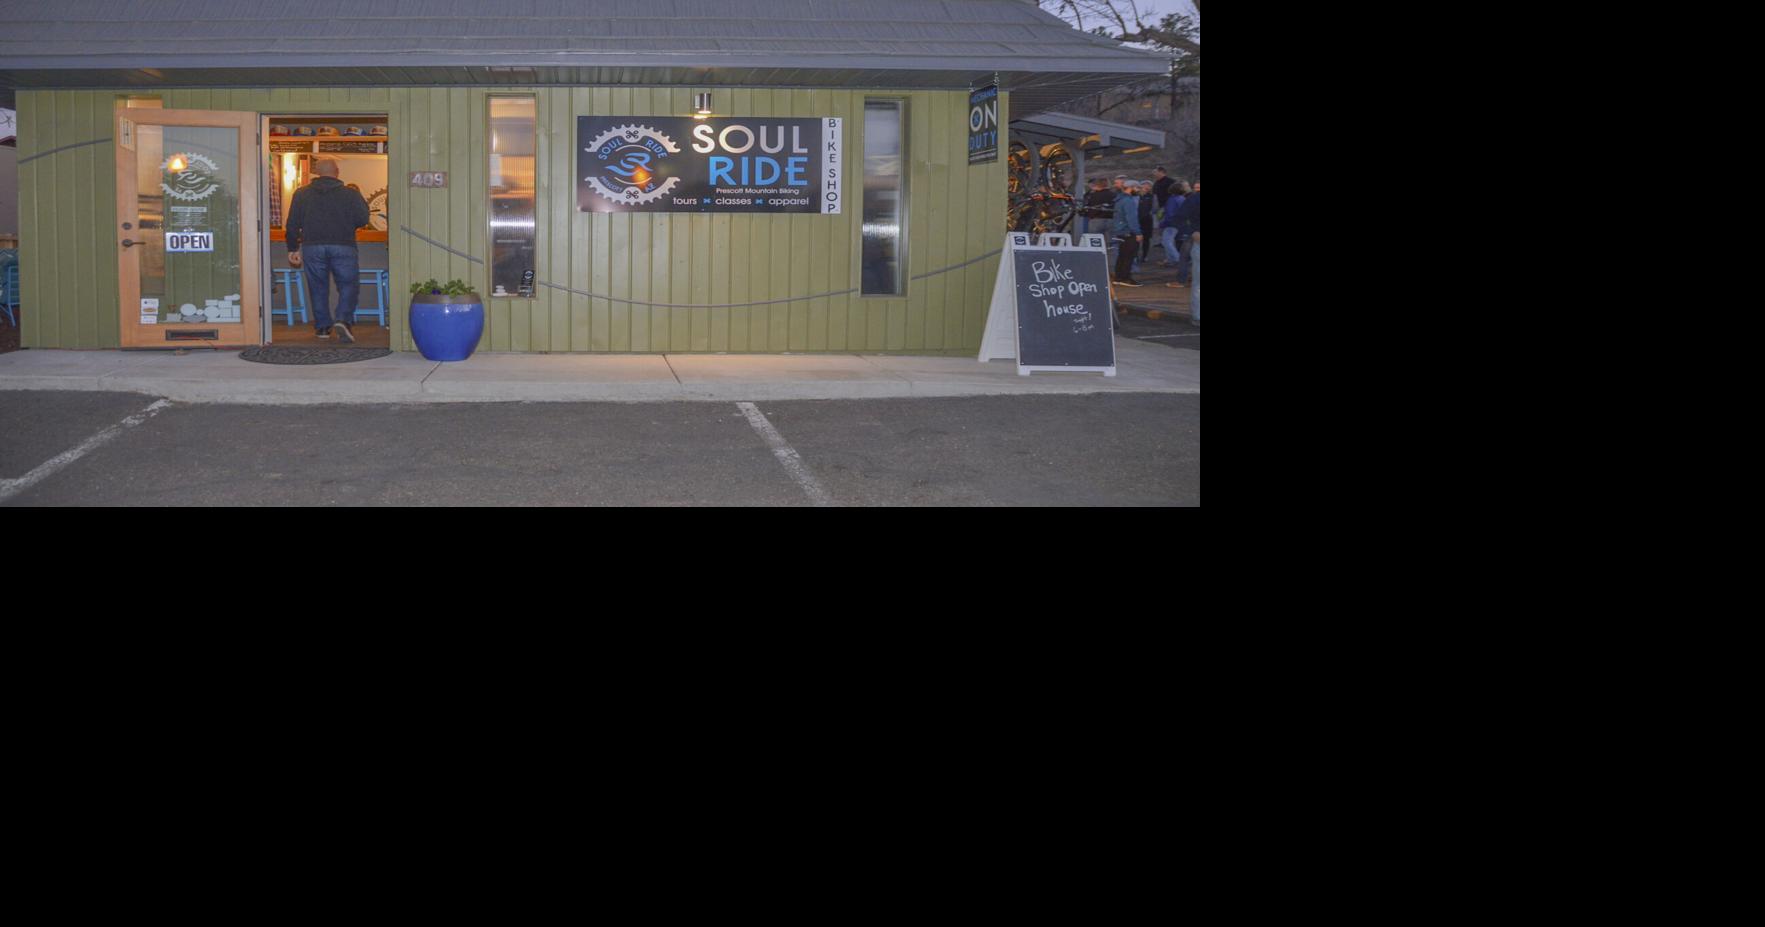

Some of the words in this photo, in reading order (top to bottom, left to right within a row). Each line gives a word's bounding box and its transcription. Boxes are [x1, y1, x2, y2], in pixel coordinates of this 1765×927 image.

[970, 100, 997, 132] ON
[598, 138, 623, 160] SOUL
[645, 139, 667, 159] RIDE
[692, 124, 808, 154] SOUL
[827, 118, 836, 163] BIKE
[969, 129, 996, 151] DUTY
[412, 172, 443, 186] 409
[708, 156, 808, 186] RIDE
[673, 196, 697, 205] tours
[715, 196, 752, 205] classes
[768, 197, 809, 206] apparel
[779, 187, 800, 195] Biking
[826, 169, 838, 213] SHOP
[169, 235, 210, 249] OPEN
[1032, 259, 1074, 283] Bike
[1029, 284, 1065, 299] Shop
[1068, 281, 1097, 297] Open
